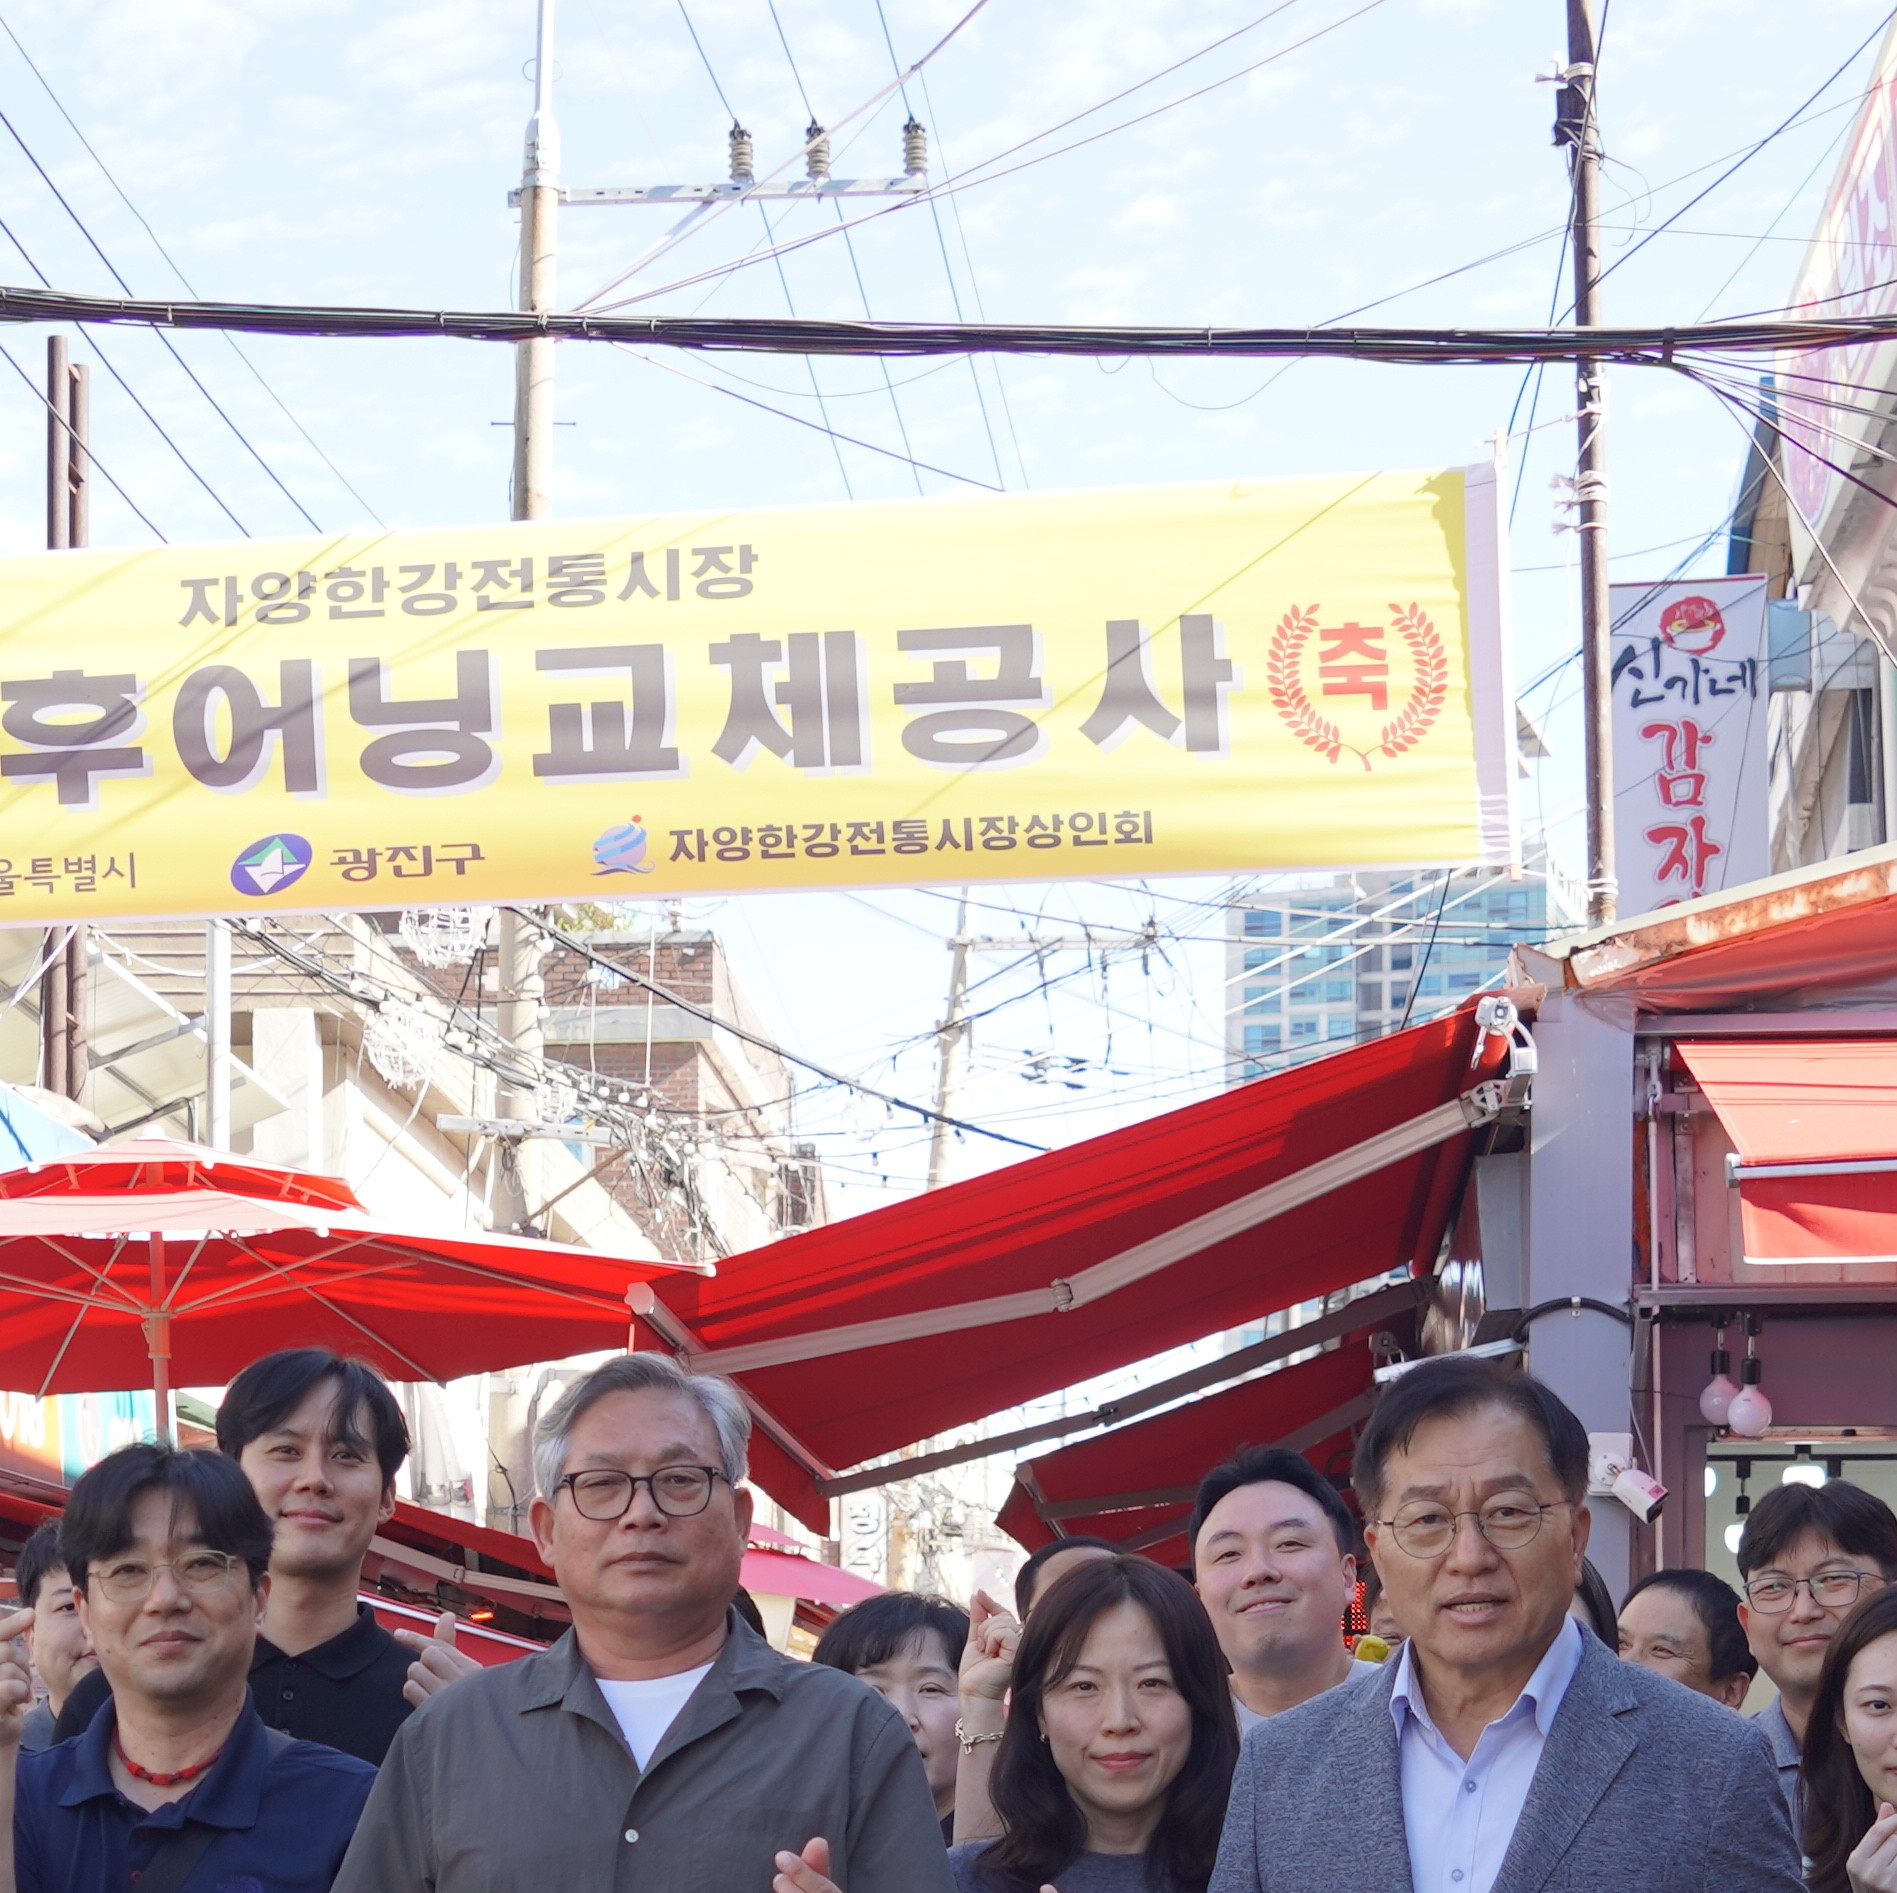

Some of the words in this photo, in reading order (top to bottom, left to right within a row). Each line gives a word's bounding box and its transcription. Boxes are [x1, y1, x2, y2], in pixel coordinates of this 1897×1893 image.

[178, 545, 759, 629] 자양한강전통시장
[1318, 623, 1389, 711] 축
[668, 809, 1155, 864] 자양한강전통시장상인회
[1639, 719, 1722, 910] 감자
[328, 841, 487, 882] 광진구
